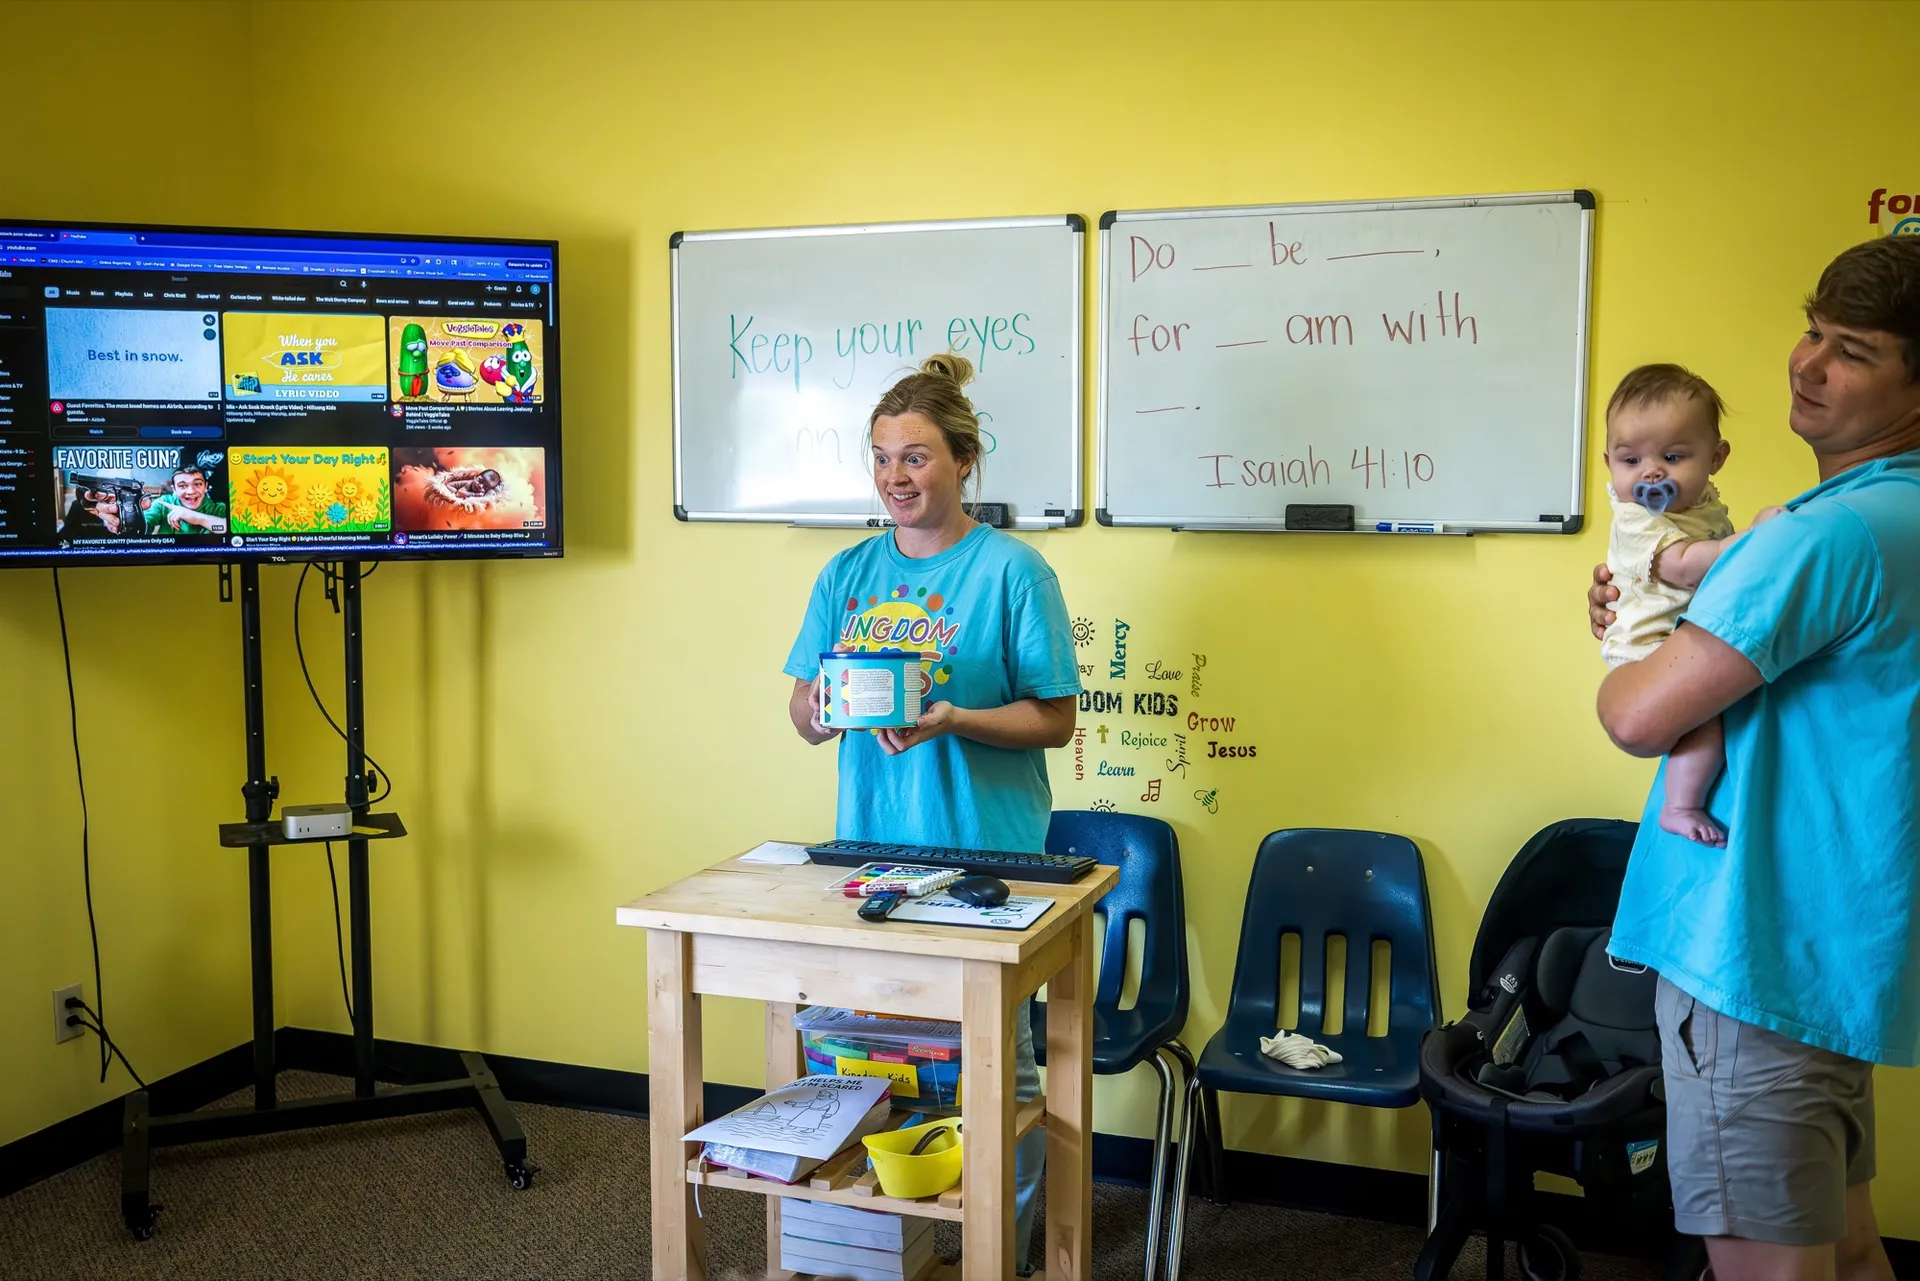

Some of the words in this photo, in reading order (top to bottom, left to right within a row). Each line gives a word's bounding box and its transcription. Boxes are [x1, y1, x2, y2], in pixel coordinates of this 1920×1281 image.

[1129, 235, 1176, 283] Do
[1269, 221, 1308, 268] be
[446, 324, 494, 334] VeggieTales
[1127, 314, 1190, 356] for
[1285, 313, 1353, 346] am
[1383, 290, 1478, 345] with
[278, 334, 313, 347] When
[315, 337, 337, 351] you
[88, 350, 121, 361] Best
[125, 350, 138, 361] in
[142, 353, 183, 362] snow.
[281, 352, 324, 365] ASK
[729, 314, 813, 393] Keep
[833, 318, 923, 389] your
[947, 313, 1035, 373] eyes
[282, 370, 300, 383] He
[302, 374, 334, 382] cares
[275, 389, 306, 397] LYRIC
[308, 390, 340, 398] VIDEO
[58, 449, 134, 469] FAVORITE
[136, 449, 180, 469] GUN?
[242, 453, 277, 465] Start
[280, 454, 310, 465] Your
[314, 454, 339, 467] Day
[342, 453, 376, 467] Right
[1199, 445, 1331, 489] Isaiah
[1350, 446, 1435, 490] 41:10
[841, 612, 960, 648] INGDOM
[1109, 618, 1131, 680] Mercy
[1144, 660, 1184, 681] Love
[1190, 652, 1207, 698] Praise
[1133, 692, 1179, 717] KIDS
[1187, 711, 1236, 733] Grow
[1121, 730, 1168, 750] Rejoice
[1207, 741, 1257, 759] Jesus
[1074, 727, 1087, 781] Heaven
[1166, 733, 1190, 779] Spirit
[1097, 760, 1136, 777] Learn
[888, 1073, 910, 1084] Kids
